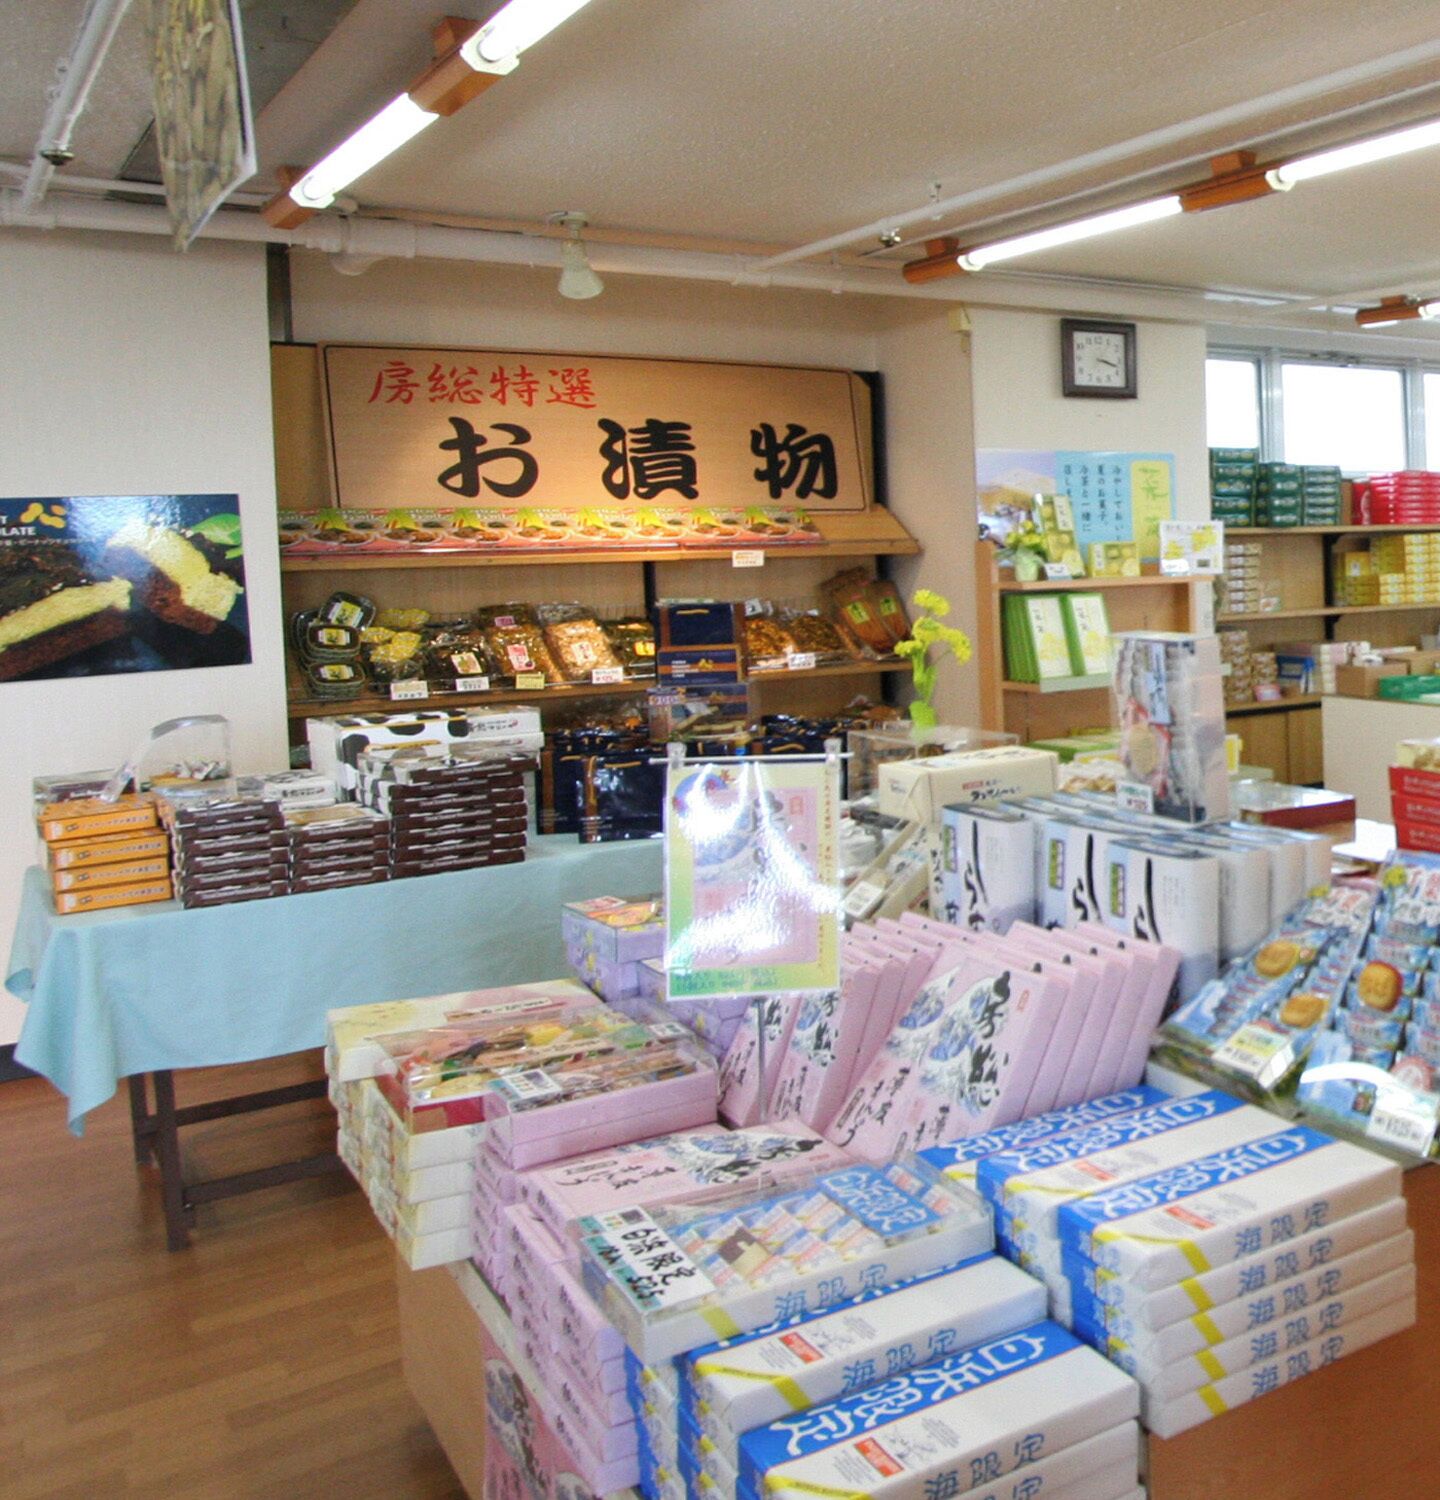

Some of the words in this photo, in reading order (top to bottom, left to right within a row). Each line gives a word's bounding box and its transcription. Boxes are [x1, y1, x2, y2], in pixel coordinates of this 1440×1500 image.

[368, 361, 597, 409] 房総特選
[437, 416, 838, 500] お漬物
[0, 526, 36, 537] LATE
[1233, 1200, 1330, 1259] 海限定
[775, 1263, 888, 1322] 海限定
[1236, 1236, 1333, 1296] 海限定
[1247, 1268, 1342, 1330] 海限定
[843, 1327, 957, 1390] 海限定
[1248, 1301, 1345, 1364] 海限定
[1252, 1335, 1345, 1399] 海限定
[924, 1433, 1044, 1500] 海限定
